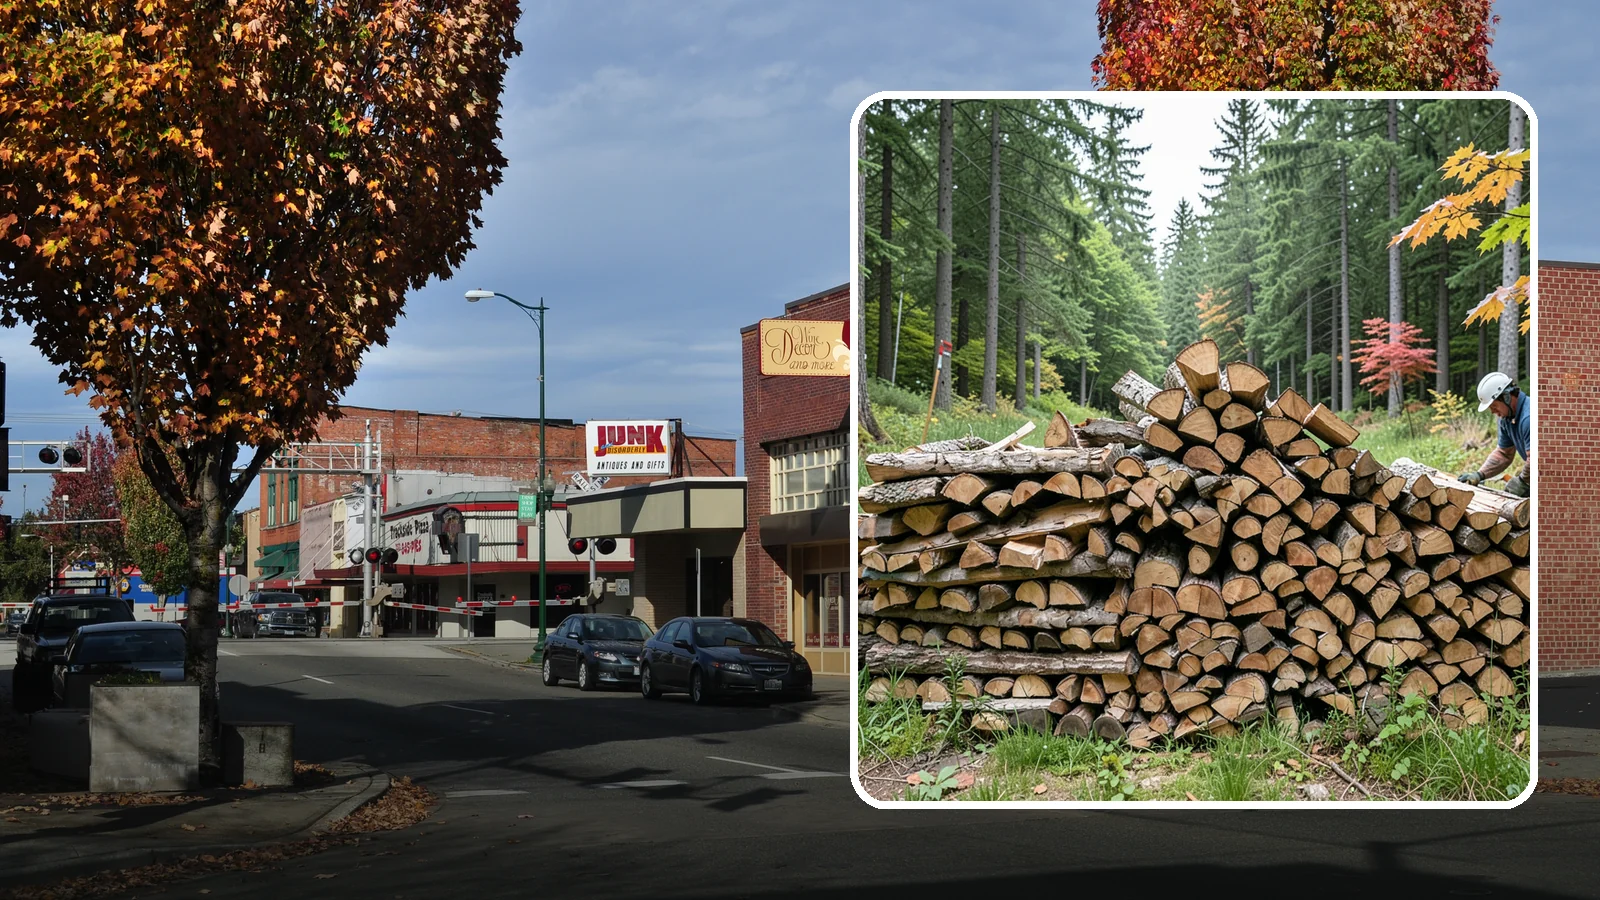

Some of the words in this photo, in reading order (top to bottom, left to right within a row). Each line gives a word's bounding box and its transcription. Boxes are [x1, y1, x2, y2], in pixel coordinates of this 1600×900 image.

[595, 425, 664, 457] JUNK
[607, 446, 646, 454] DISORDERLY
[597, 461, 628, 470] ANTIQUES
[631, 460, 644, 470] AND
[647, 460, 665, 469] GIFTS
[414, 519, 429, 535] Pizza
